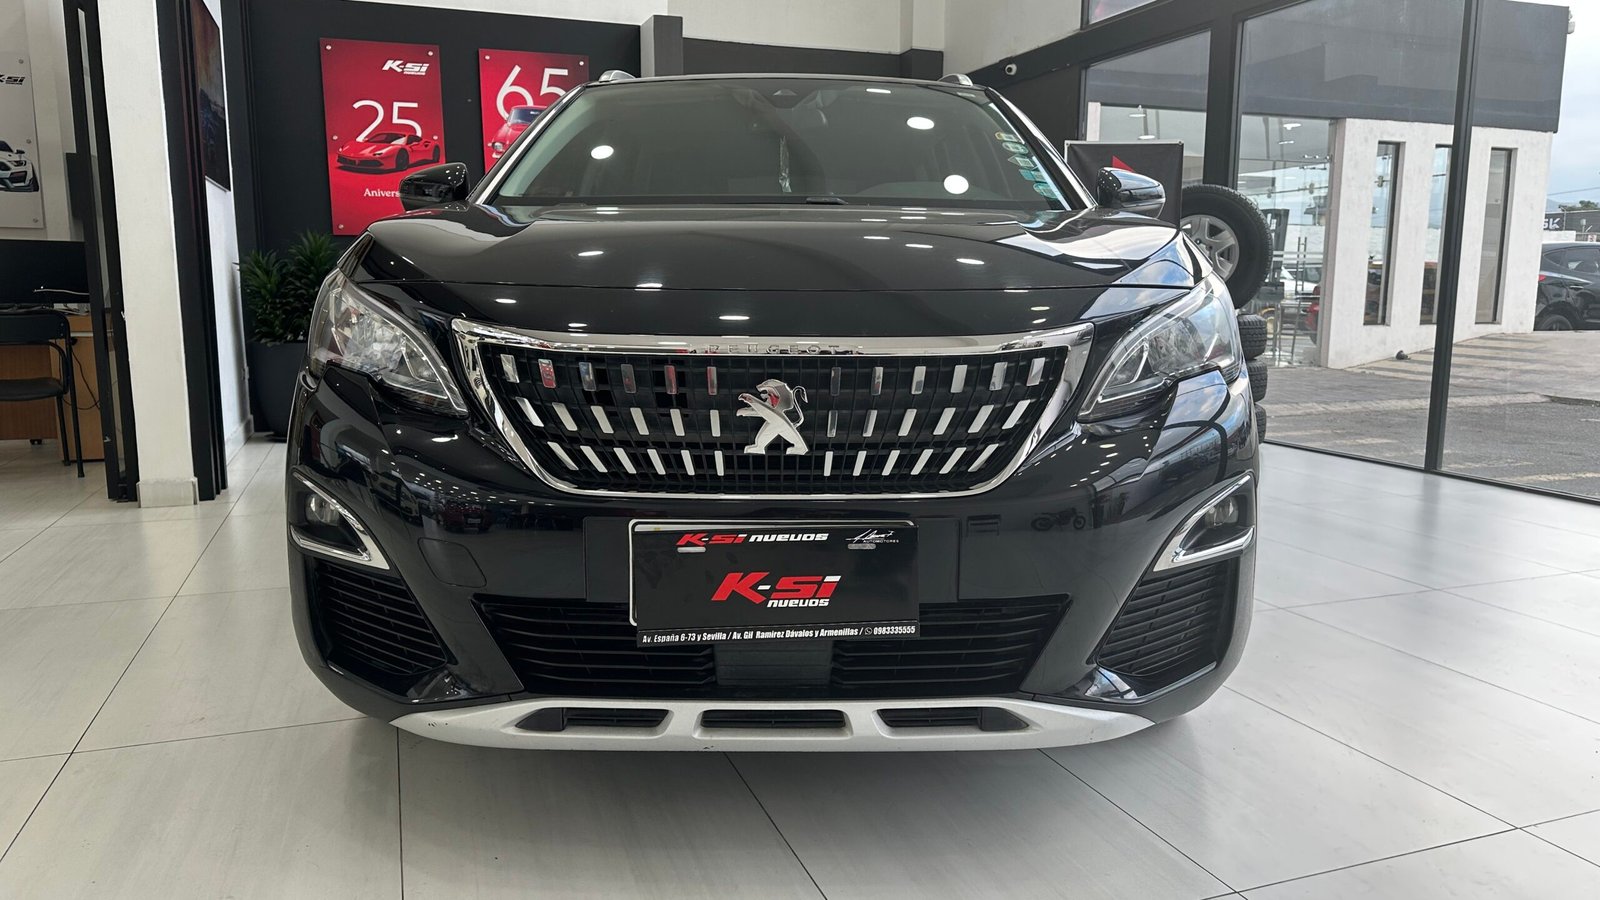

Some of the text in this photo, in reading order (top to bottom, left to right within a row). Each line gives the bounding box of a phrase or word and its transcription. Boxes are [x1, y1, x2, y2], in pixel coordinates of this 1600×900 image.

[496, 65, 568, 120] 65
[353, 100, 422, 142] 25
[708, 344, 840, 355] PEUGEOT
[643, 635, 652, 643] Av.
[654, 634, 679, 642] España
[680, 633, 695, 641] 6-73
[703, 631, 726, 640] Sevilla
[732, 631, 742, 639] Av.
[786, 629, 813, 638] Dávalos
[820, 627, 858, 636] Armenillas
[873, 625, 916, 635] 0983335555
